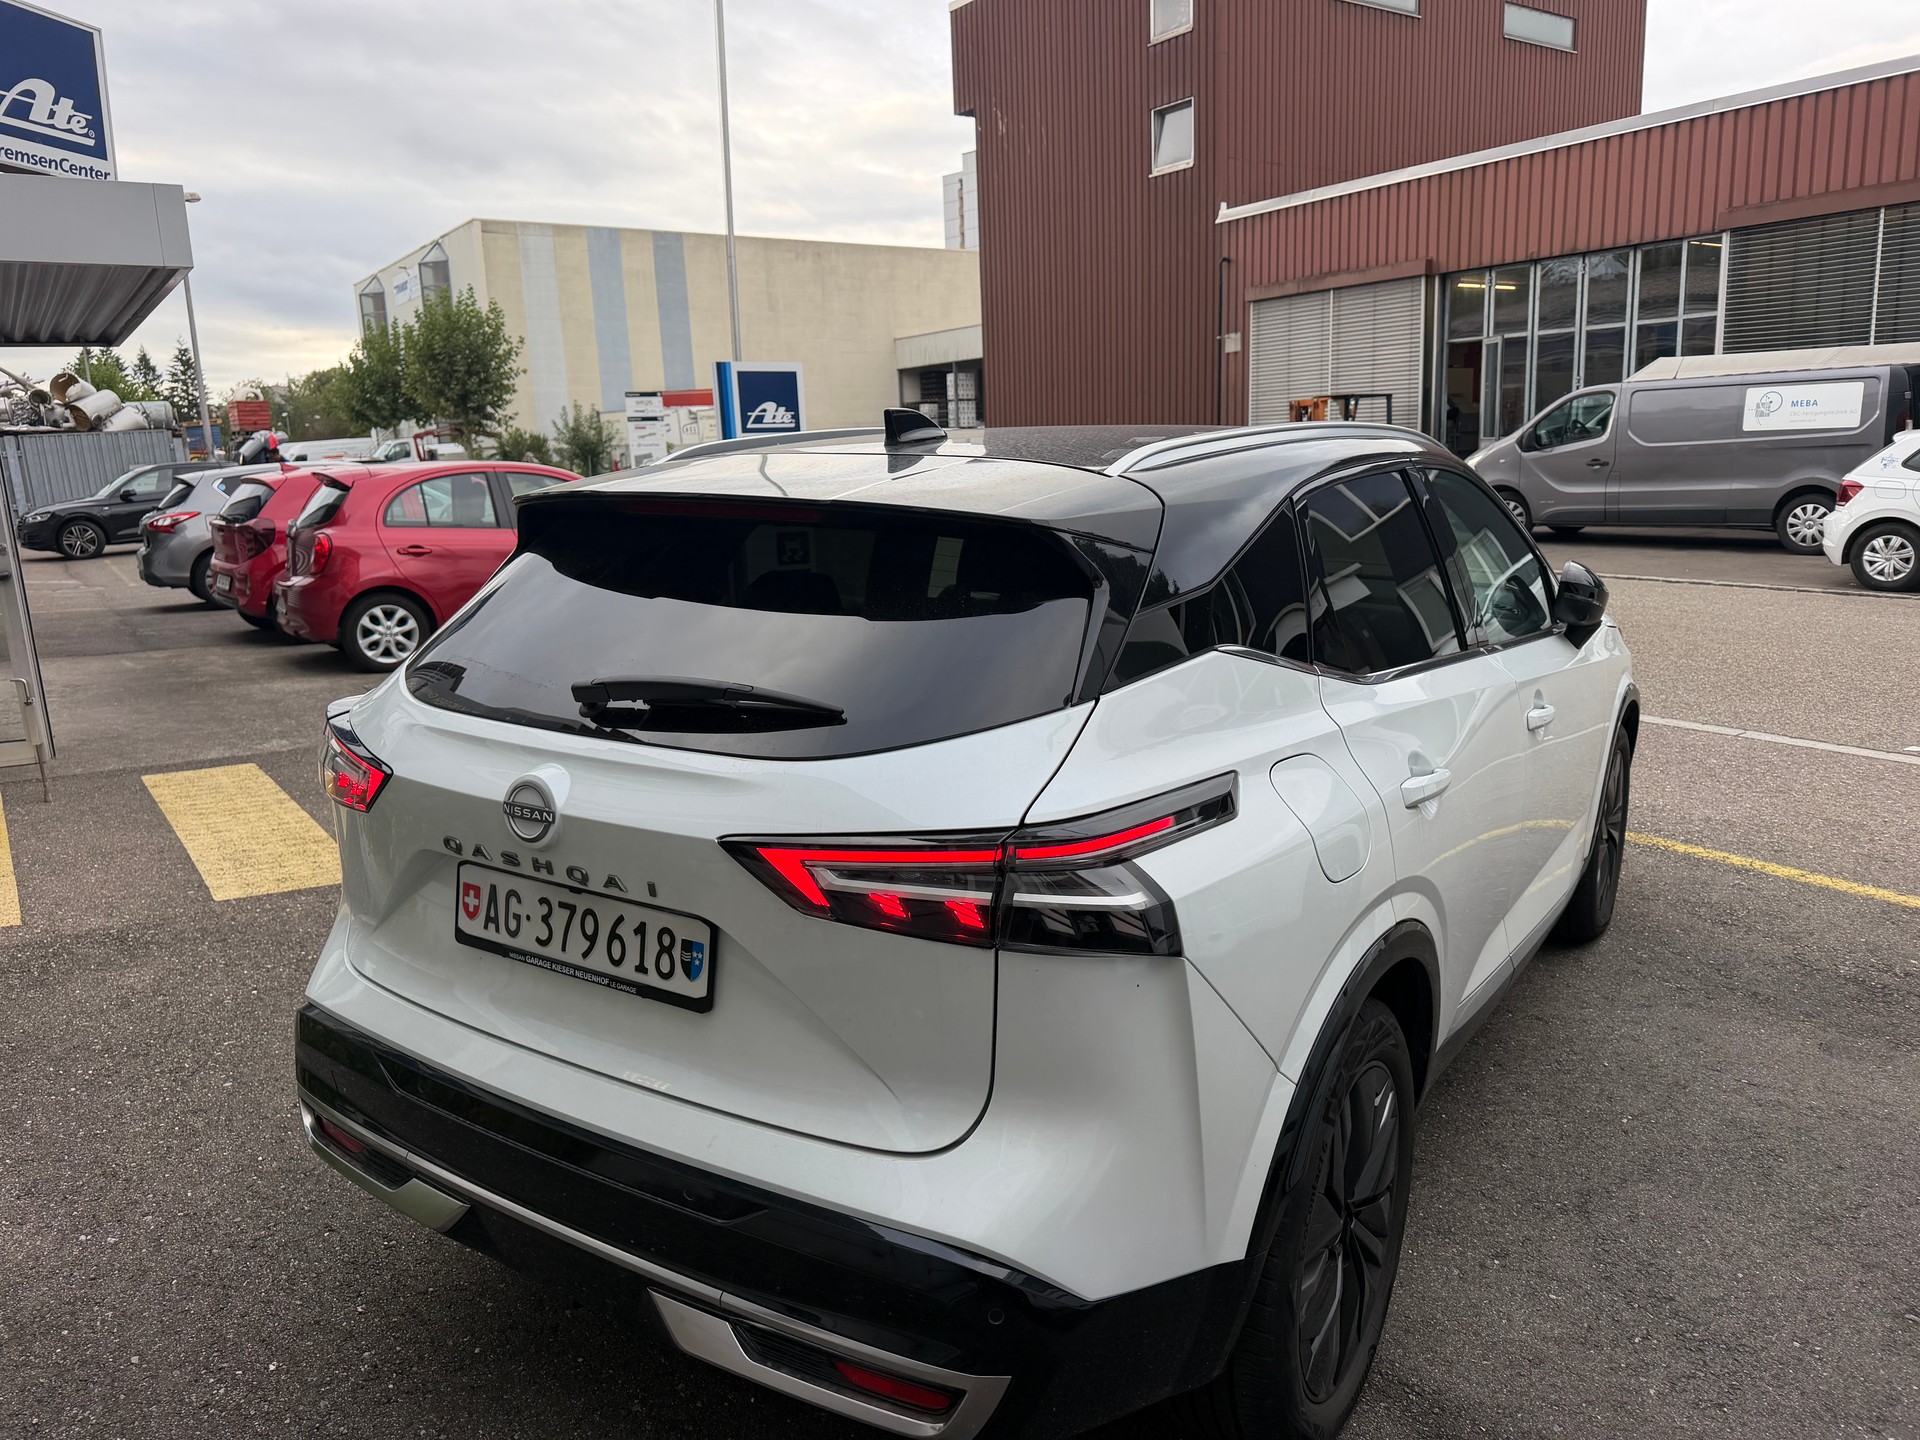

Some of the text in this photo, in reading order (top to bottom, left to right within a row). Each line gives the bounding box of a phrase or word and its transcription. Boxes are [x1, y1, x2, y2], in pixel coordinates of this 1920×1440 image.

[1790, 399, 1819, 408] MEBA
[503, 802, 553, 823] NISSAN
[443, 835, 658, 898] QASHQAI
[508, 952, 637, 994] NISSAN GARAGE KIESER NEUENHOF LE GARAGE
